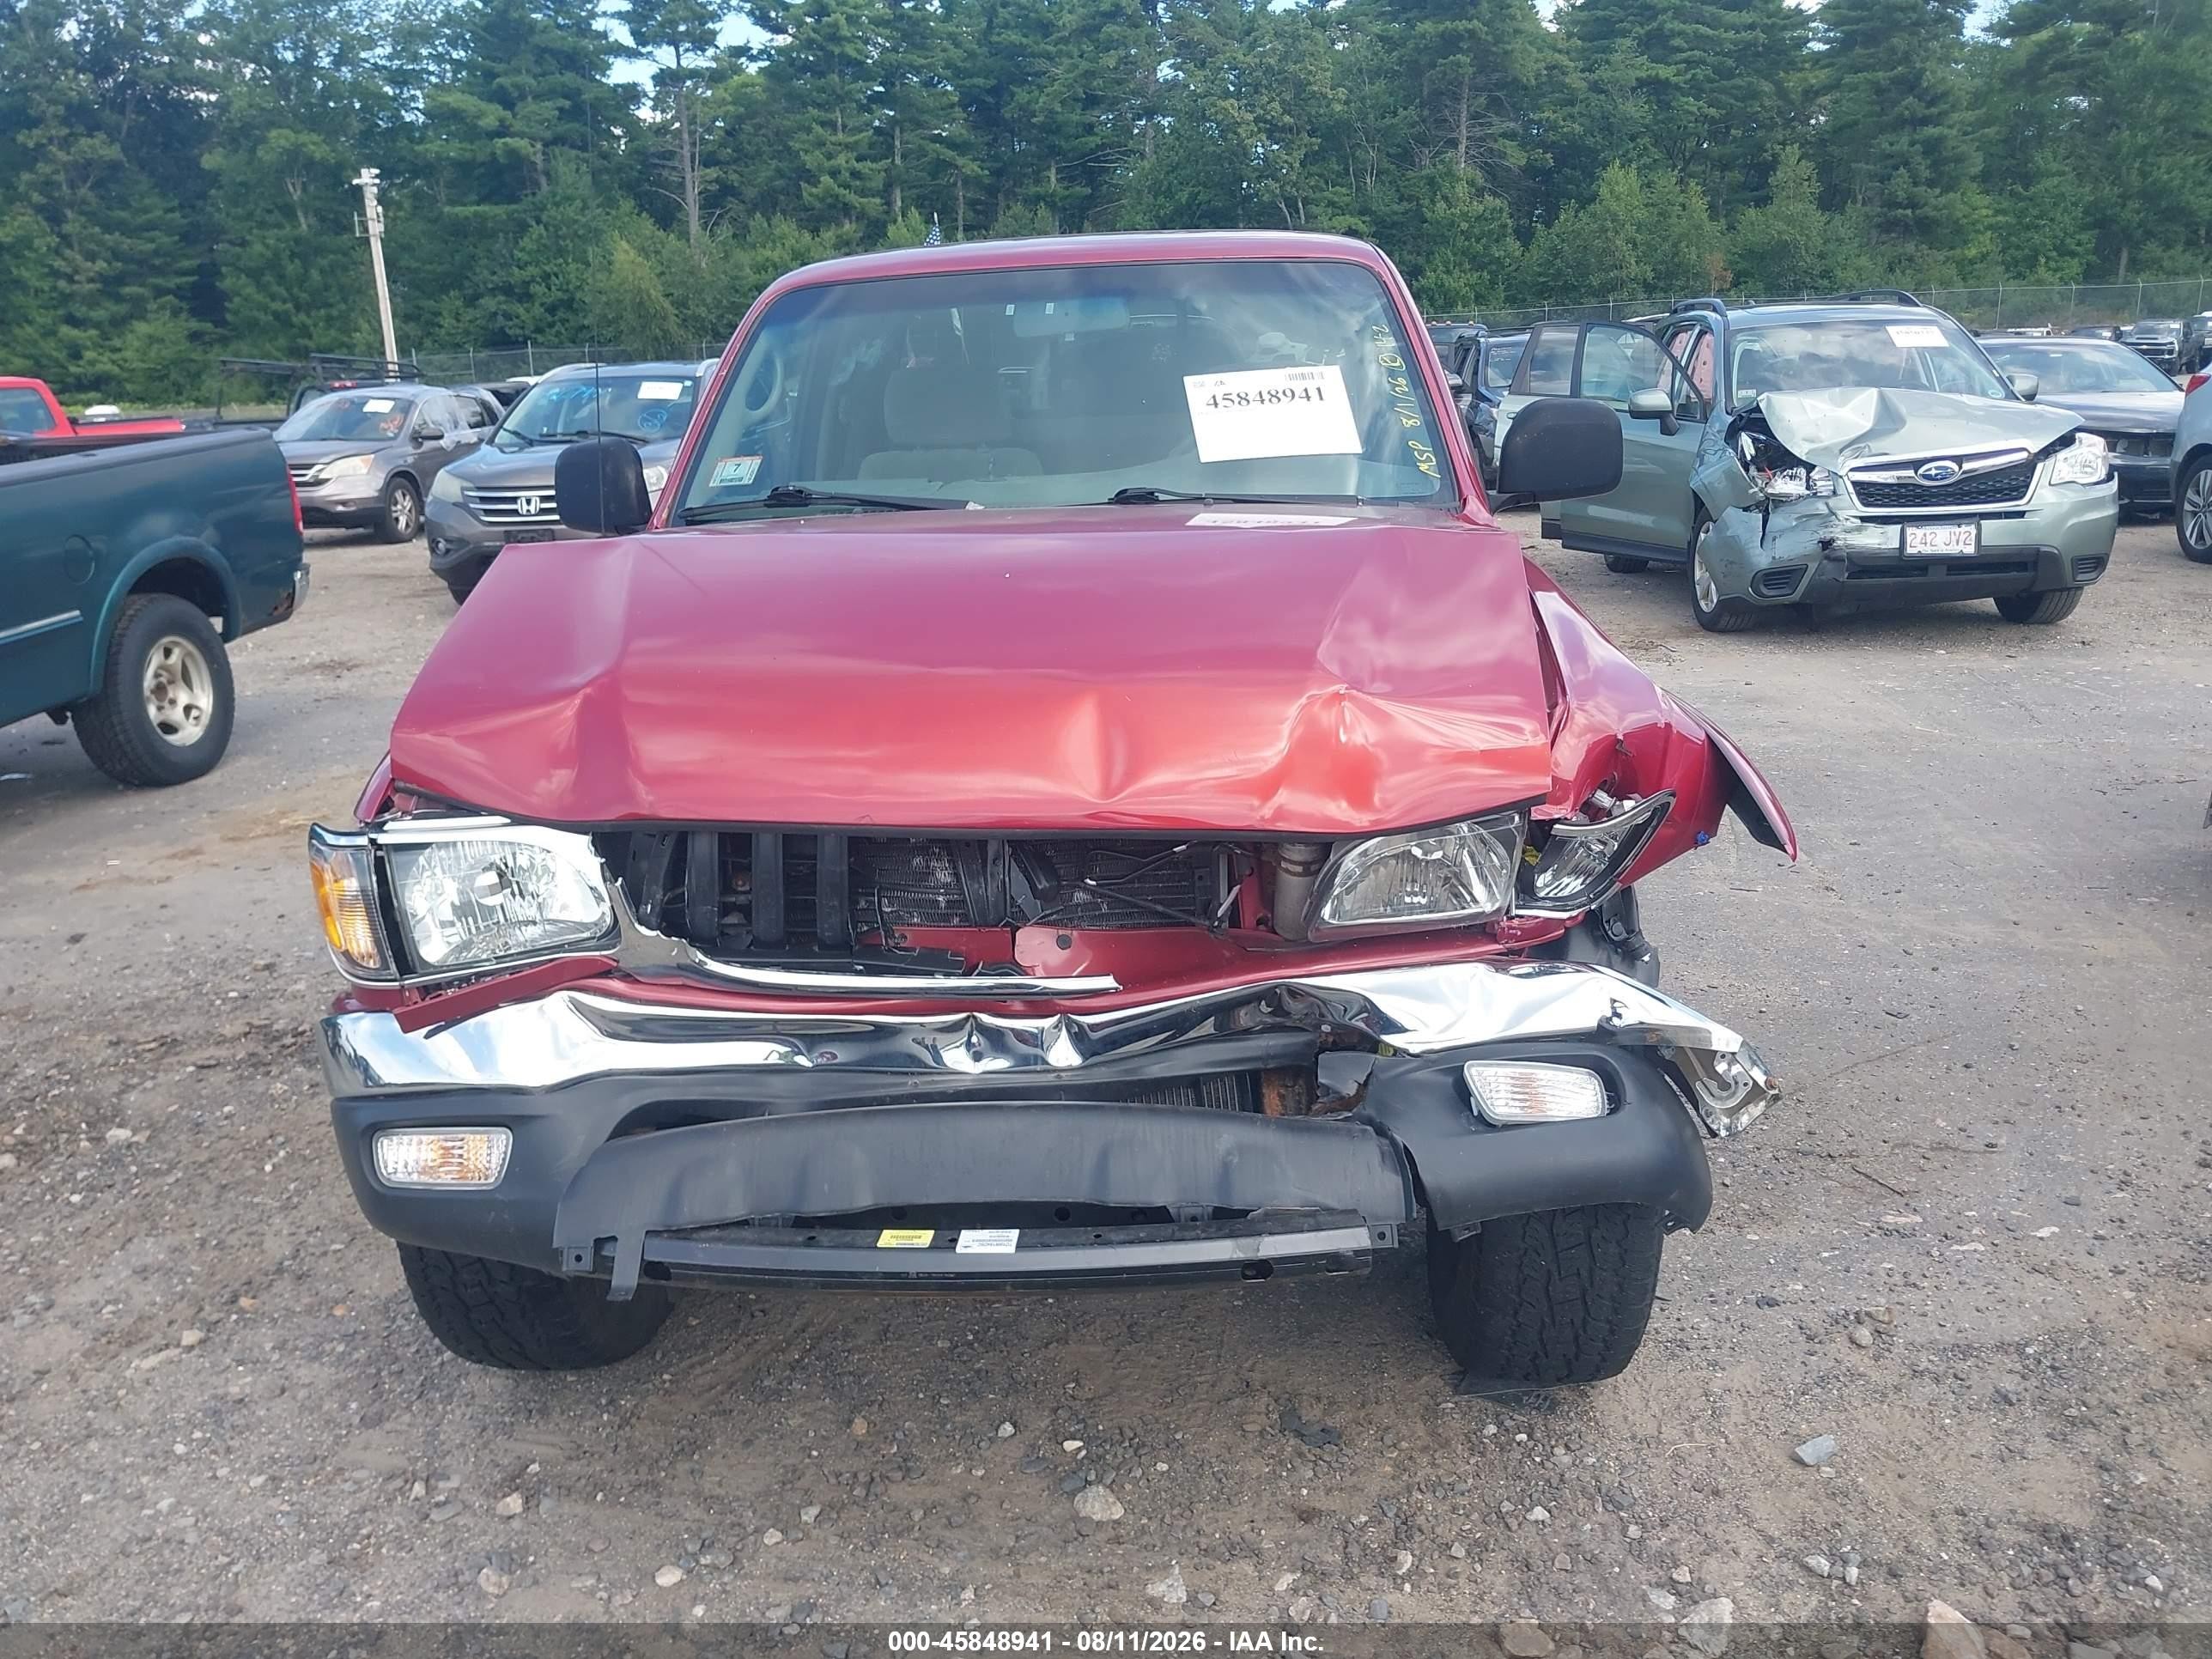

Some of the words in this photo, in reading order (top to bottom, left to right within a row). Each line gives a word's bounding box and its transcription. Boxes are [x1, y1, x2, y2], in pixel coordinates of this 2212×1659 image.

[1206, 386, 1326, 409] 45848941
[1387, 376, 1421, 428] 8/1/26
[733, 463, 742, 472] 7
[1407, 440, 1442, 478] MSP
[1908, 531, 1938, 549] 242
[1943, 530, 1972, 547] JV2
